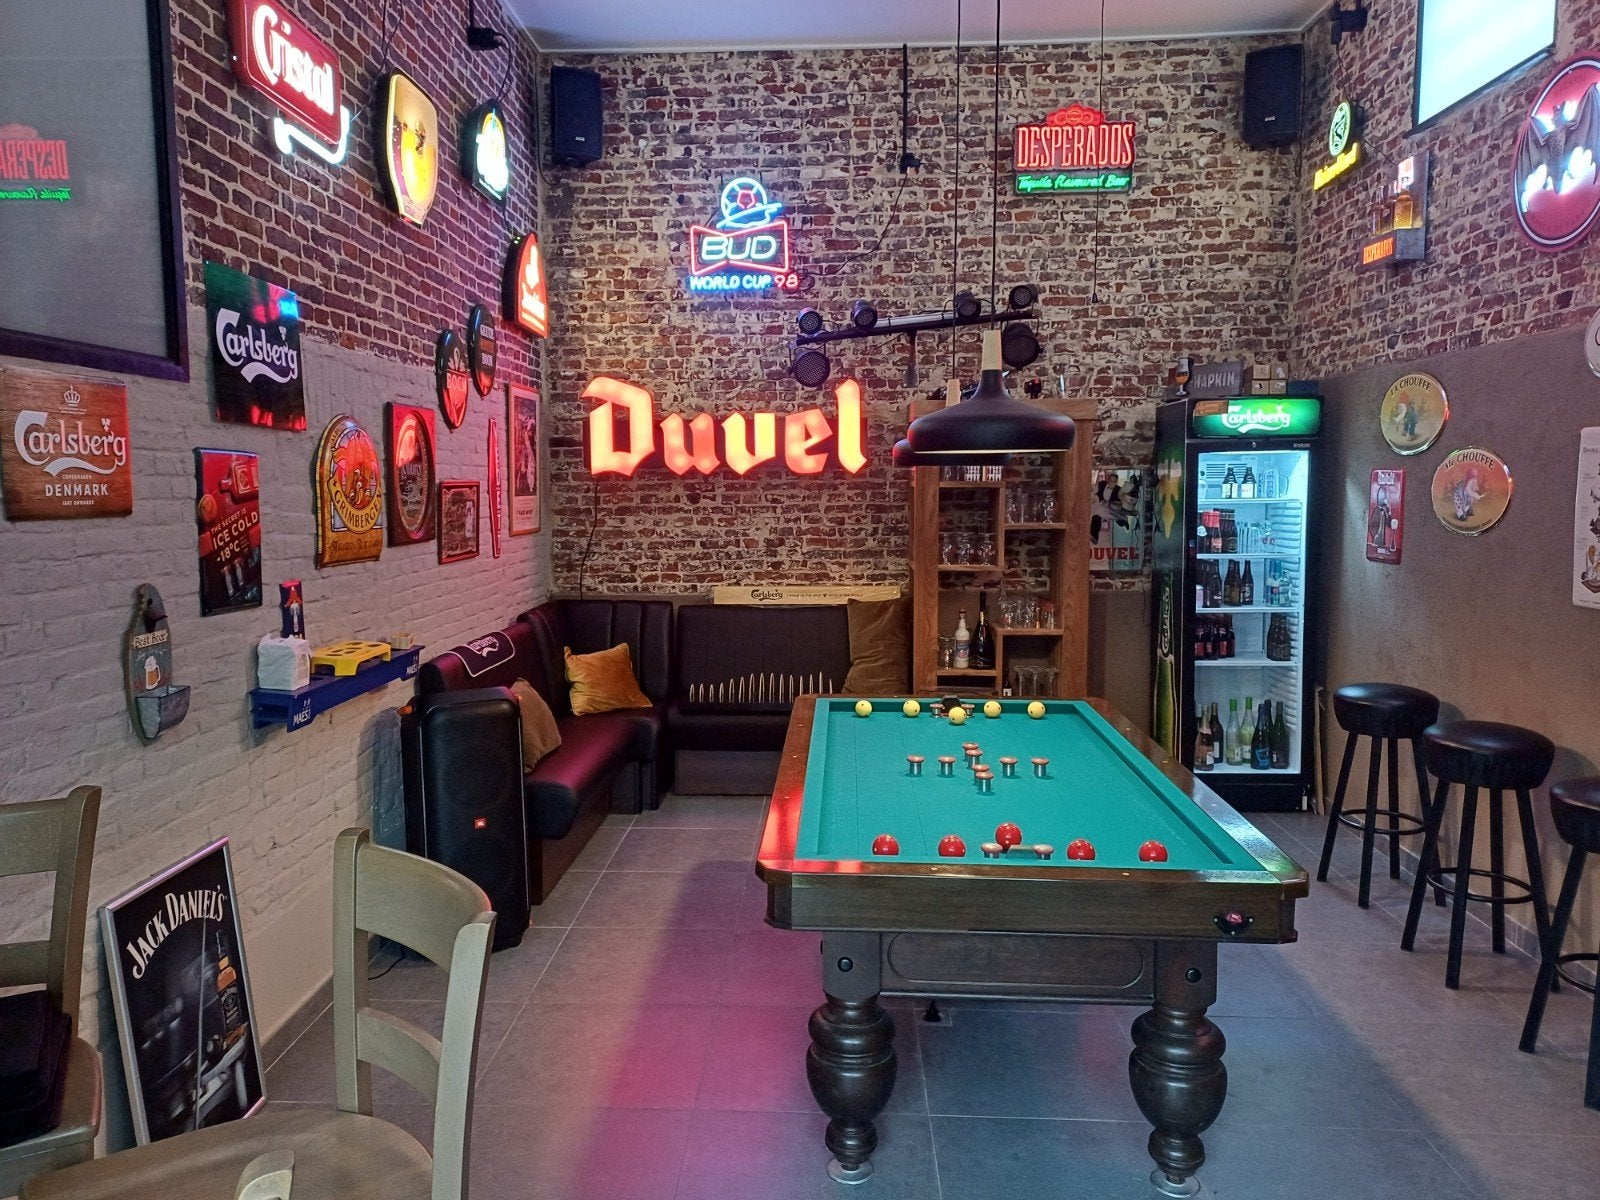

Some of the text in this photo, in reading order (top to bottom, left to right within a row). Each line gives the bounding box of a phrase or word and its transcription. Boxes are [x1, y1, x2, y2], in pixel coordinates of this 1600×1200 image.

[1018, 124, 1133, 167] DESPERADOS
[1018, 175, 1053, 192] Tequila
[1105, 174, 1130, 188] Beer
[701, 235, 777, 261] BUD
[690, 275, 740, 291] WORLD
[215, 308, 299, 382] Carlsberg
[1400, 376, 1432, 392] CHOUFFE
[581, 376, 867, 477] Duvel
[1221, 405, 1292, 434] Carlsberg
[14, 410, 127, 473] Carlsberg
[1456, 452, 1496, 471] CHOUFFE
[45, 483, 109, 497] DENMARK
[210, 522, 222, 535] THE
[222, 510, 241, 528] SECRET
[213, 528, 230, 550] ICE
[231, 510, 259, 537] COLD
[750, 588, 784, 602] Carlsberg
[292, 708, 309, 727] MAES
[125, 884, 226, 980] JACK DANIEL'S
